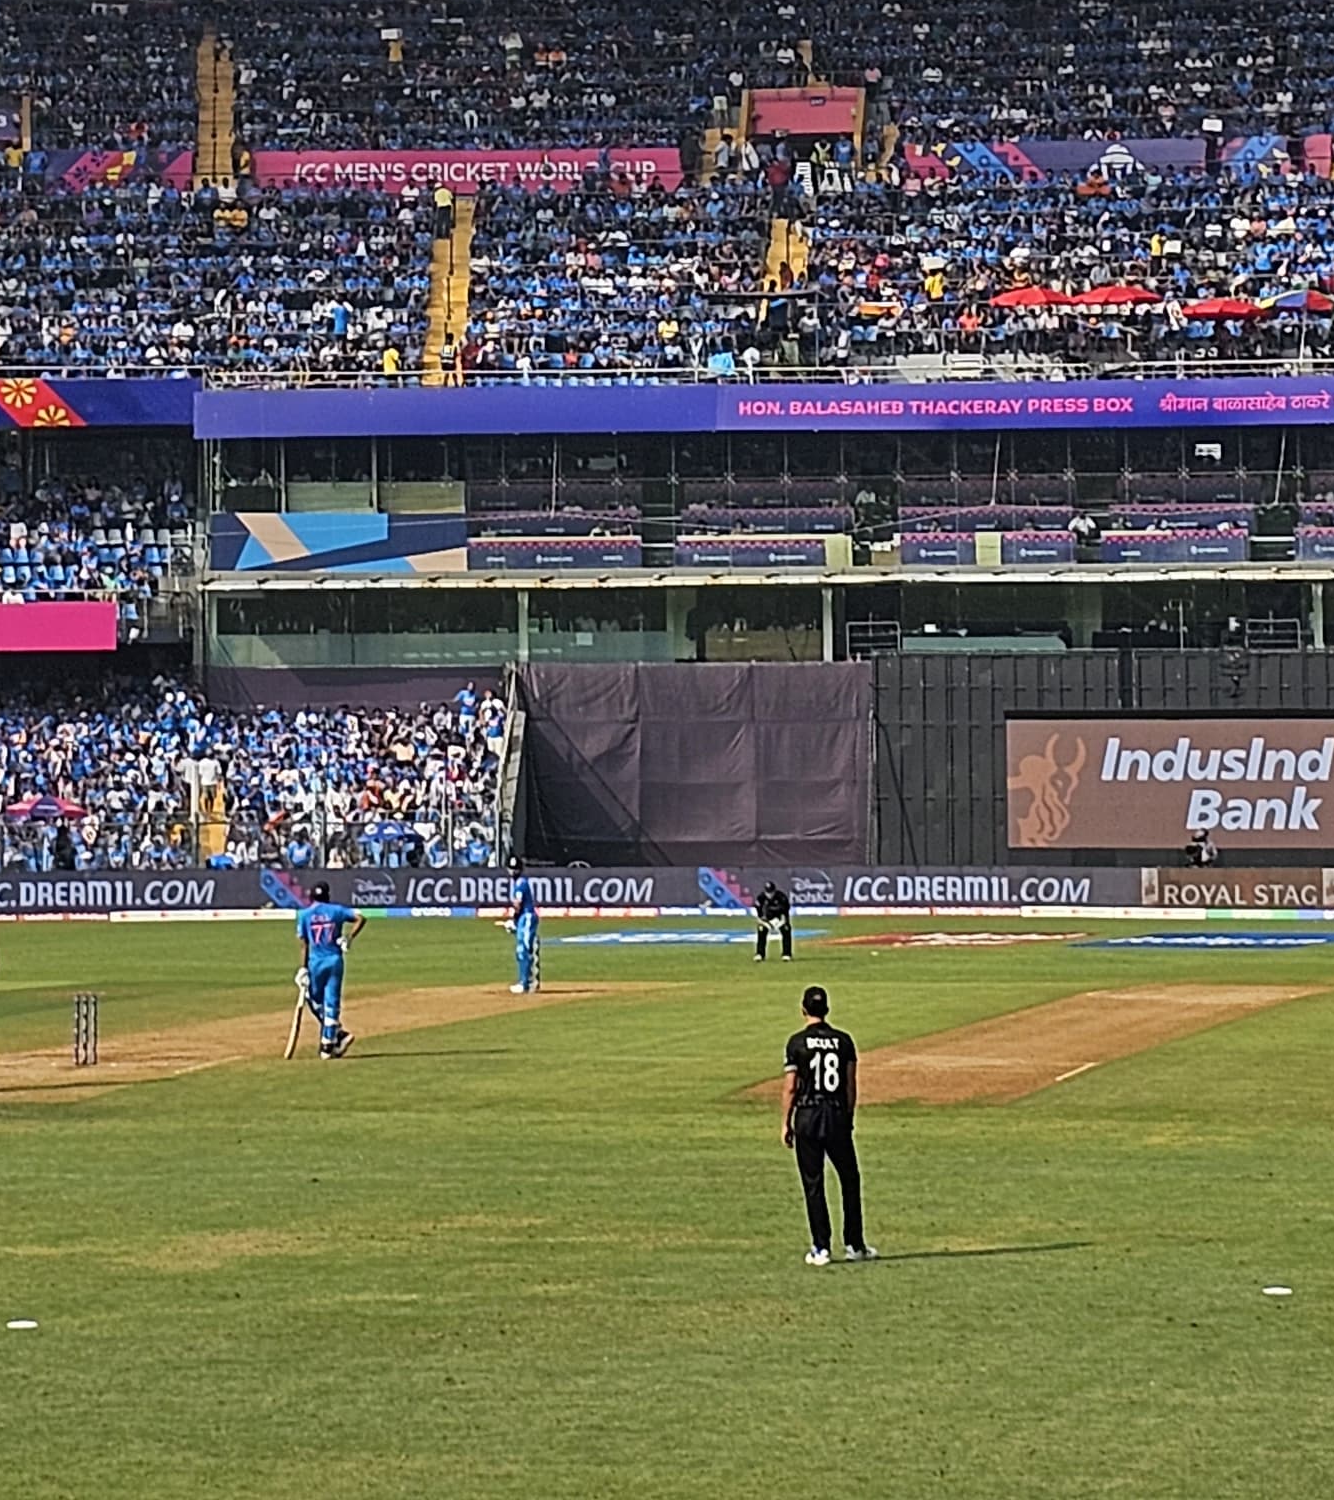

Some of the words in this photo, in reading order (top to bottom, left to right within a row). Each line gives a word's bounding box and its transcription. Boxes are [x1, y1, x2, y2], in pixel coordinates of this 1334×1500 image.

[293, 163, 330, 182] ICC
[334, 162, 406, 182] MEN'S
[411, 162, 510, 182] CRICKET
[738, 401, 785, 415] HON.
[790, 400, 904, 414] BALASAHEB
[909, 399, 1023, 414] THACKERAY
[1028, 398, 1089, 412] PRESS
[1093, 397, 1133, 412] BOX
[1290, 390, 1331, 409] ठाकरे
[1101, 737, 1334, 781] IndusInd
[1186, 786, 1322, 831] Bank
[1164, 884, 1247, 905] ROYAL
[1254, 885, 1318, 906] STAG
[312, 923, 335, 944] 77
[809, 1051, 839, 1092] 18
